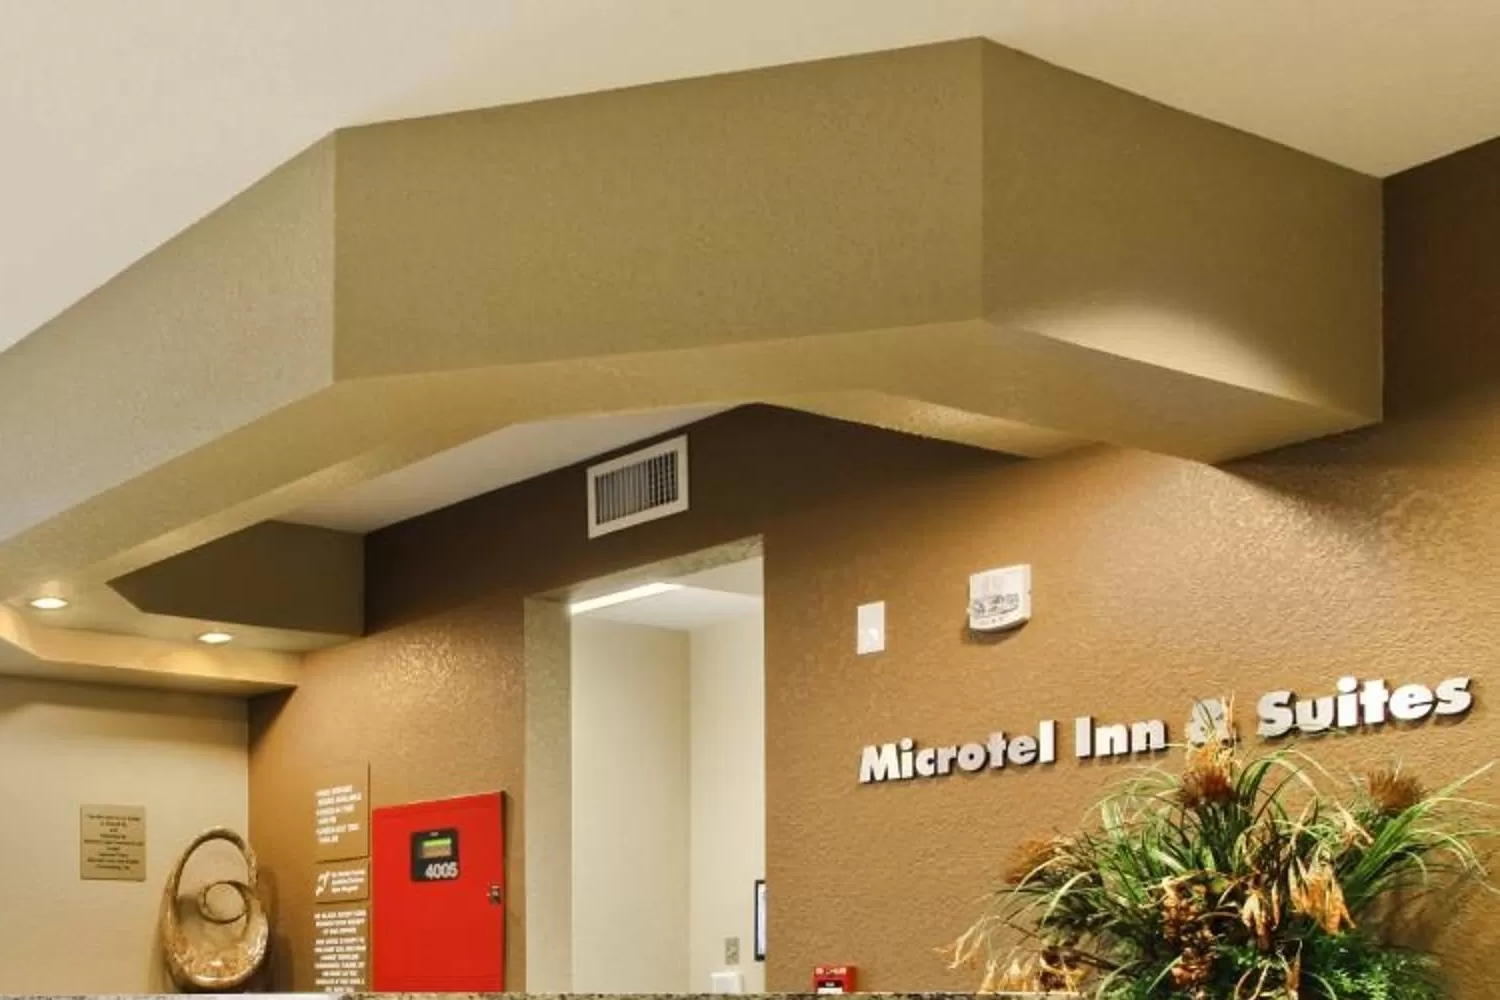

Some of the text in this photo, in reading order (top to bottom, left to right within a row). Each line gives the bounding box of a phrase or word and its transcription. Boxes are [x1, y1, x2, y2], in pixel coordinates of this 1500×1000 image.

[858, 719, 1057, 784] Microtel
[1074, 714, 1169, 759] Inn
[1256, 675, 1473, 739] Suites
[425, 861, 459, 880] 4005
